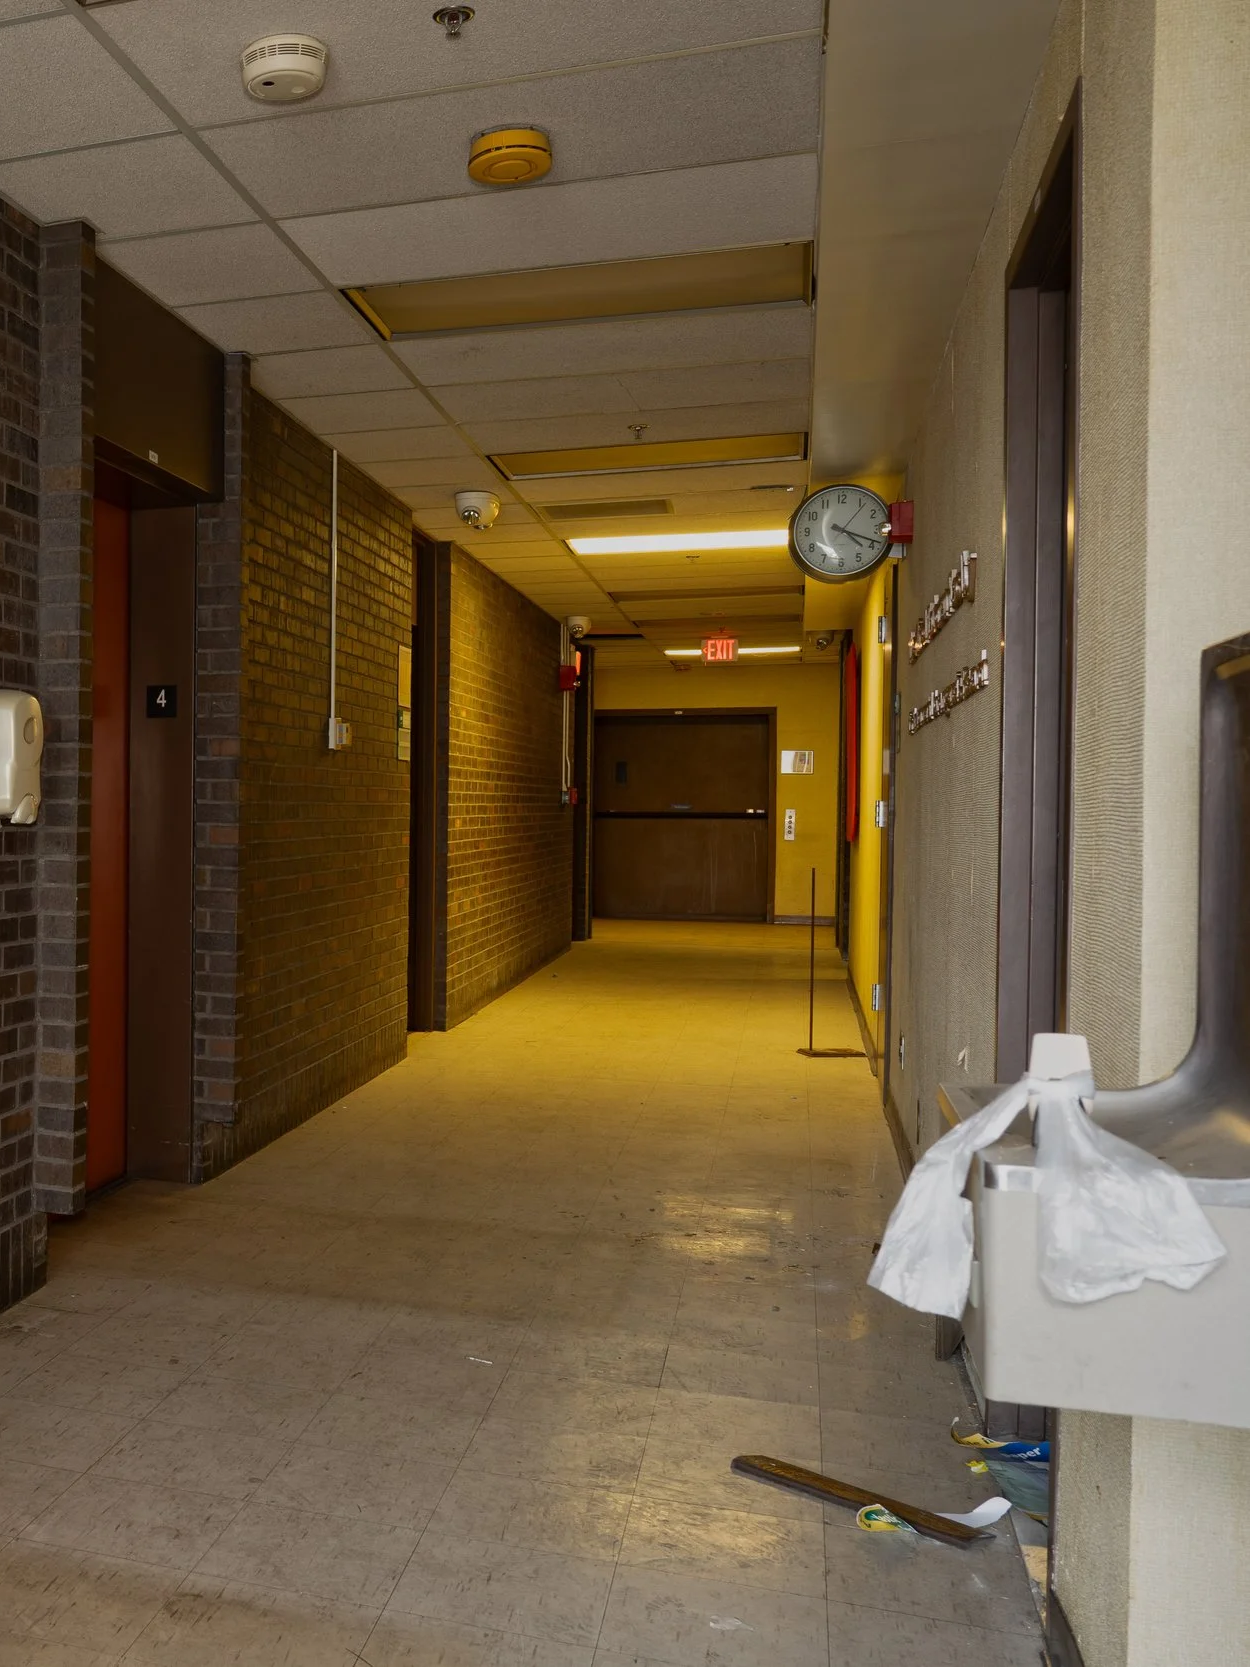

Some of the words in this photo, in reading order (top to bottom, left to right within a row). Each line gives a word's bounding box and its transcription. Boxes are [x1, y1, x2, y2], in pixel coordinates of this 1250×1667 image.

[821, 499, 829, 509] 11
[837, 494, 848, 504] 12
[808, 511, 818, 521] 10
[870, 509, 877, 519] 2
[804, 527, 810, 537] 9
[808, 543, 815, 552] 8
[868, 540, 875, 550] 4
[821, 553, 828, 563] 7
[838, 557, 844, 567] 6
[855, 552, 862, 562] 5
[707, 640, 734, 660] EXIT
[156, 689, 166, 707] 4
